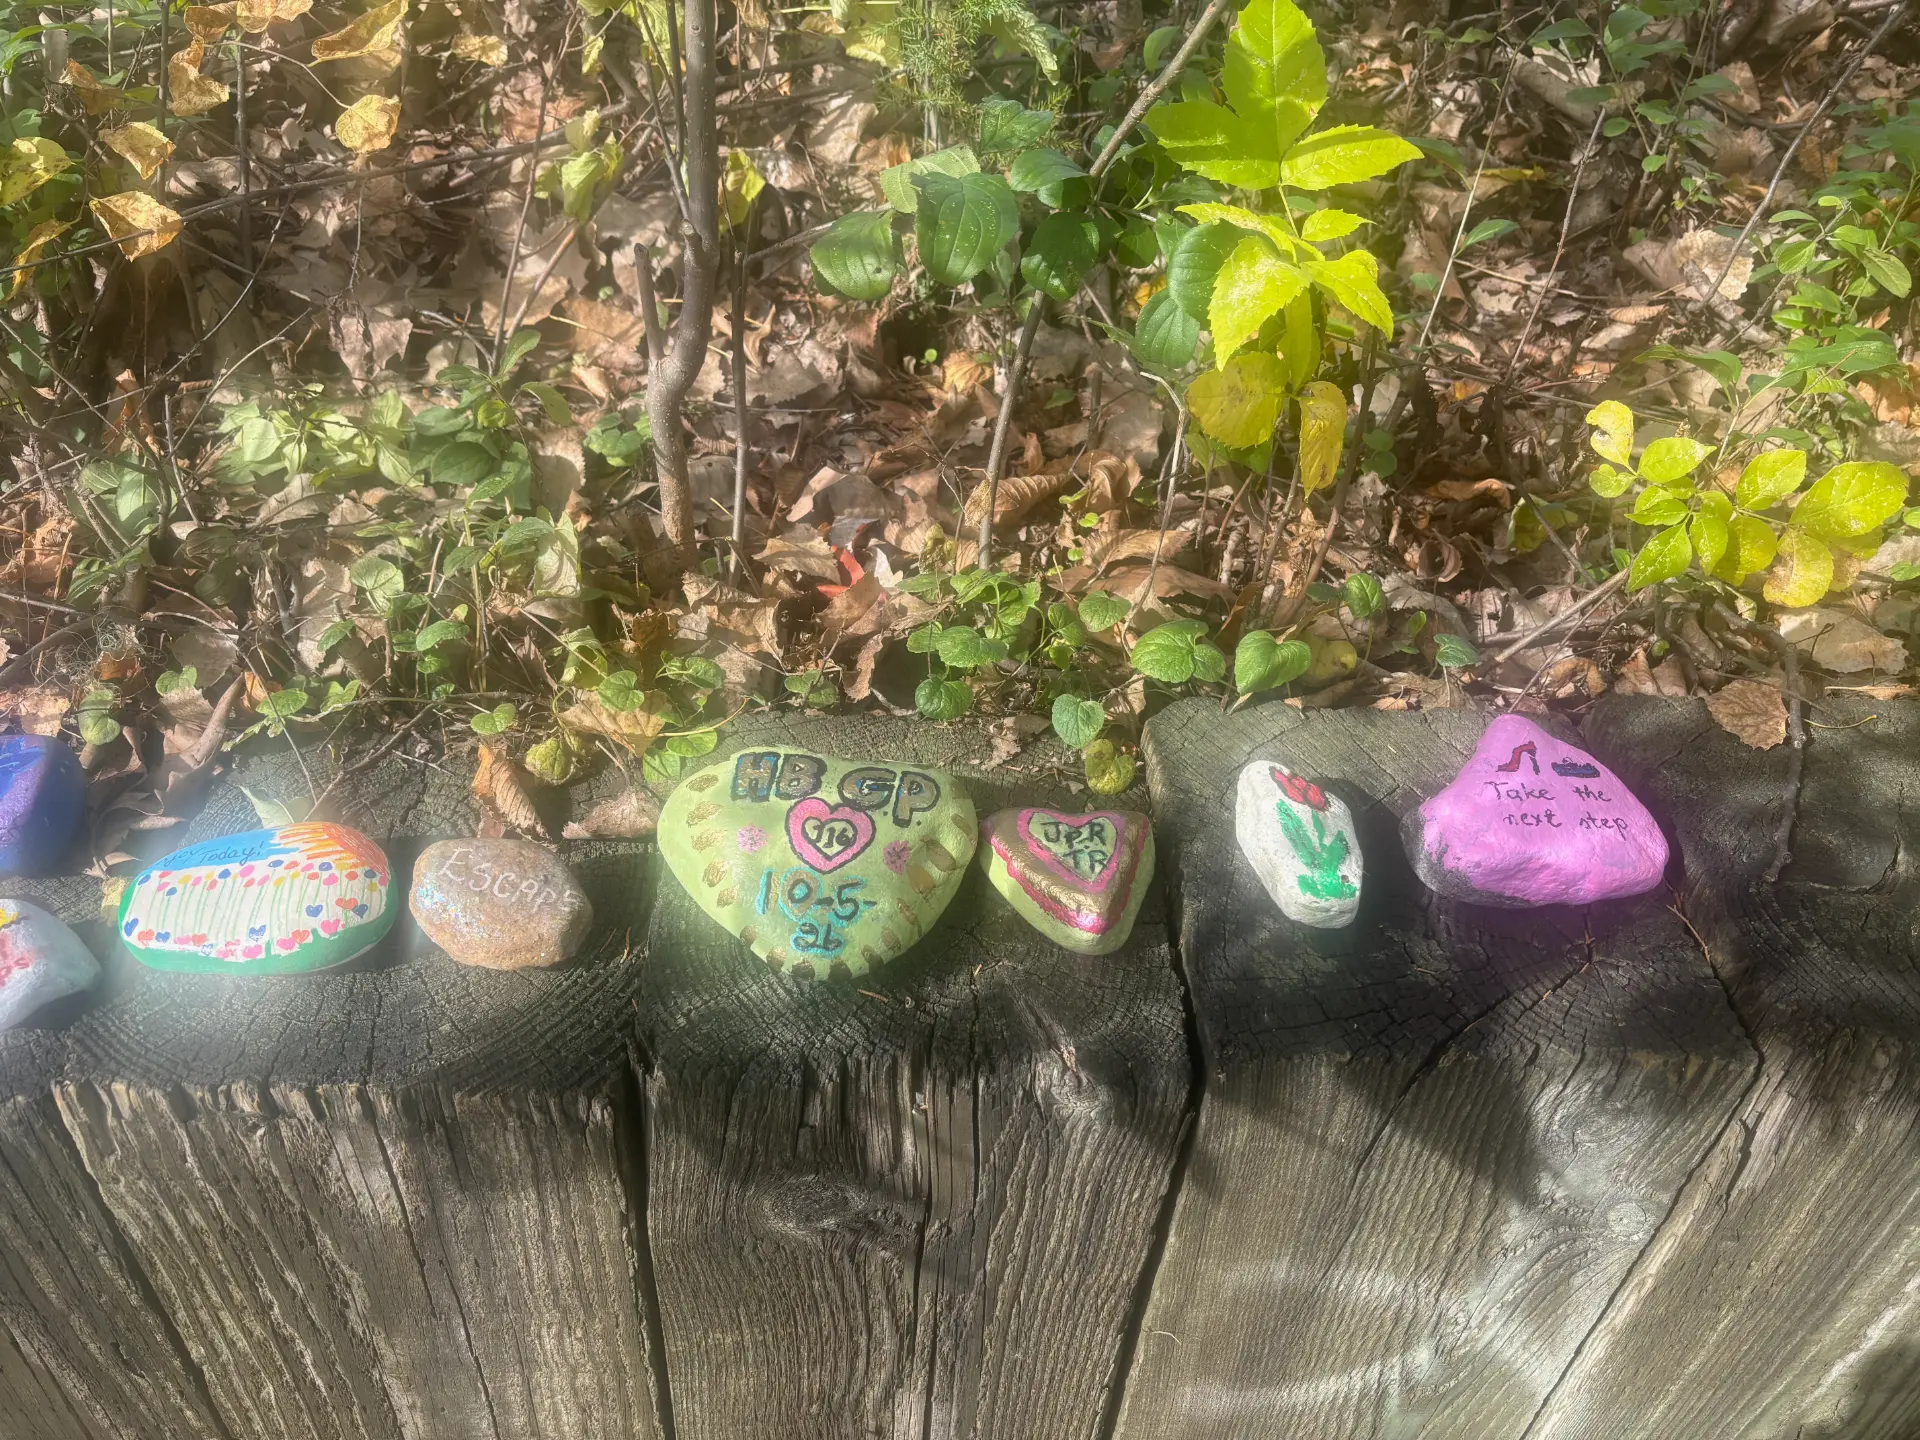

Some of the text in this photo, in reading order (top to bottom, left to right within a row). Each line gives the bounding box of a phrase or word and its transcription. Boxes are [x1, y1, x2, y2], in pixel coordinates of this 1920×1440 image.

[837, 766, 940, 827] GP
[1484, 781, 1612, 802] Take the
[1502, 809, 1629, 841] next step
[199, 841, 264, 866] Today!
[436, 847, 584, 914] ESCAPE
